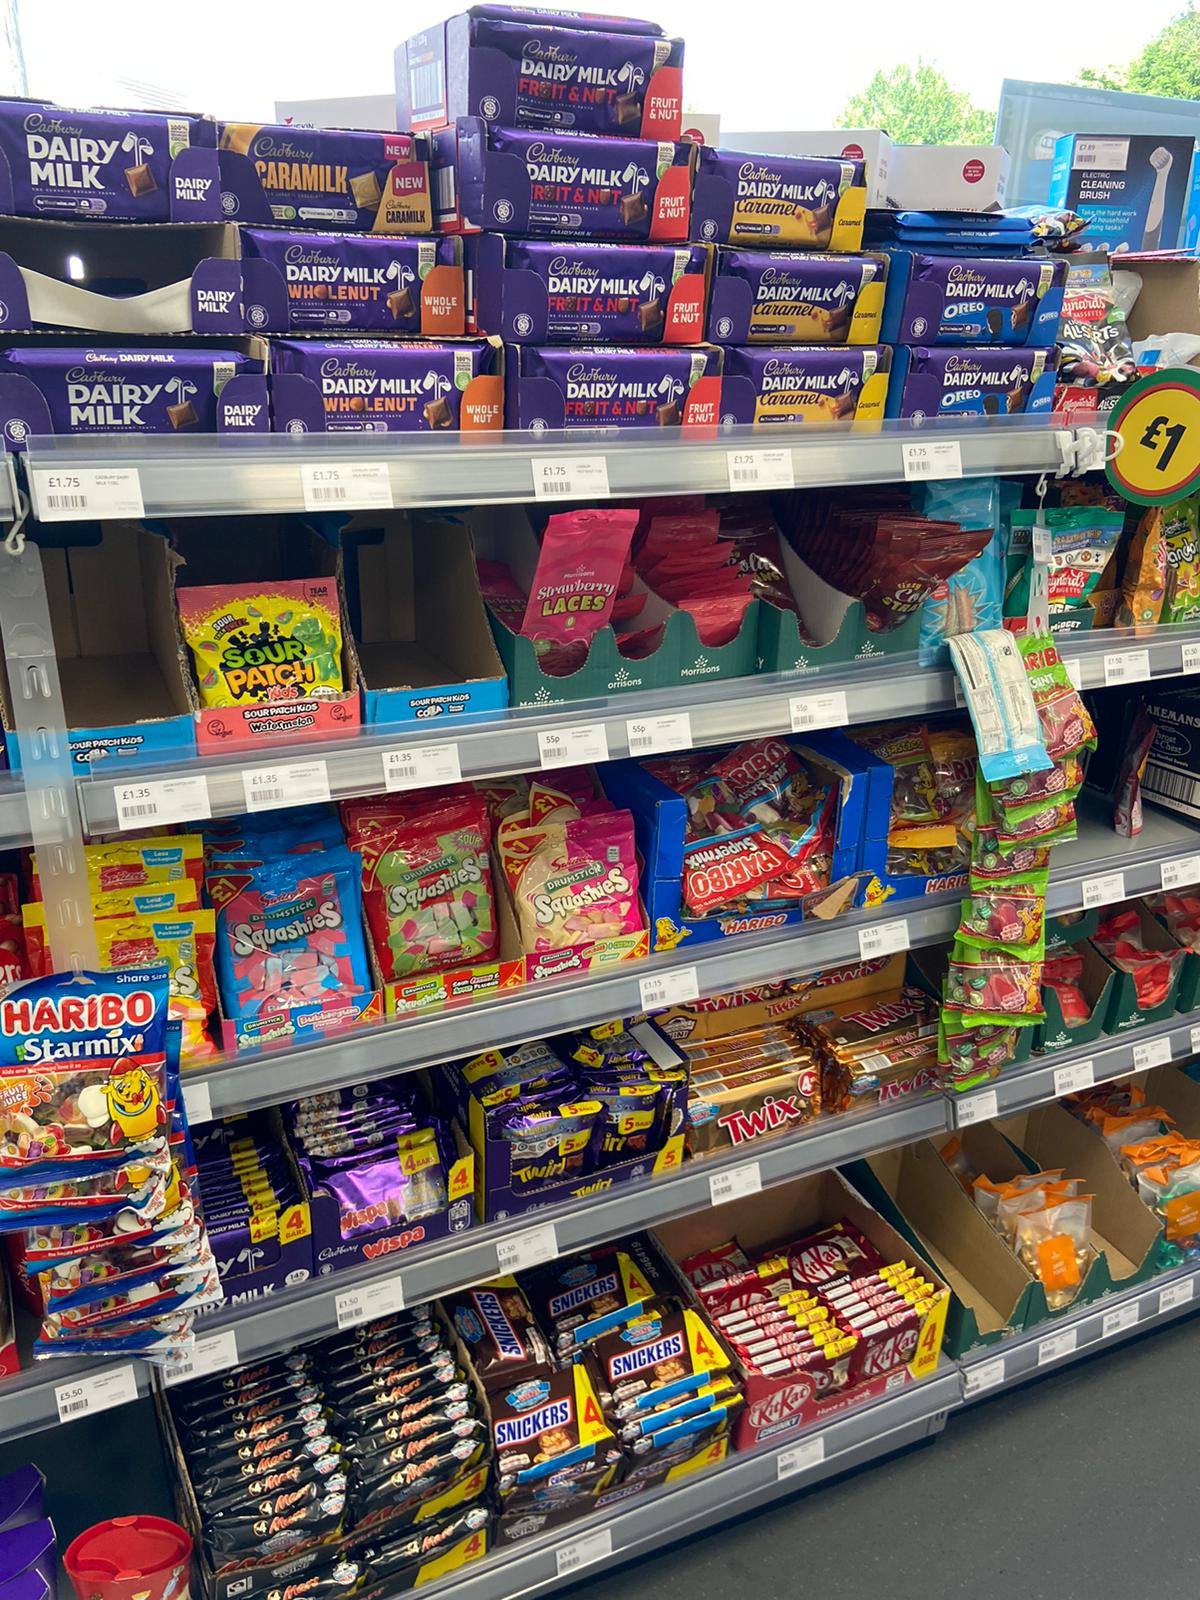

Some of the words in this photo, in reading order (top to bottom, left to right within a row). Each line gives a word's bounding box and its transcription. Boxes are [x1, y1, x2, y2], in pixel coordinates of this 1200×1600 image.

[650, 97, 678, 109] FRUIT
[649, 109, 656, 119] &
[657, 109, 679, 120] NUT
[24, 113, 83, 136] Cadbury
[26, 134, 120, 164] DAIRY
[253, 136, 313, 161] Cadbury
[385, 145, 411, 156] NEW
[30, 161, 105, 189] MILK
[254, 160, 348, 194] CARAMILK
[395, 177, 423, 189] NEW
[1080, 180, 1126, 190] CLEANING
[659, 197, 685, 208] FRUIT
[1079, 191, 1111, 200] BRUSH
[659, 208, 666, 218] &
[666, 208, 686, 218] NUT
[736, 198, 799, 216] Caramel
[386, 210, 425, 224] CARAMILK
[284, 245, 340, 265] Cadbury
[548, 256, 599, 277] Cadbury
[600, 280, 640, 295] MILK
[757, 286, 801, 300] DAIRY
[800, 287, 833, 301] MILK
[946, 282, 985, 298] DAIRY
[198, 301, 229, 313] MILK
[424, 297, 457, 307] WHOLE
[674, 303, 699, 313] FRUIT
[754, 303, 814, 316] Caramel
[432, 305, 452, 316] NUT
[672, 313, 679, 323] &
[680, 313, 700, 323] NUT
[944, 302, 985, 319] OREO
[65, 366, 126, 385] Cadbury
[320, 357, 376, 378] Cadbury
[566, 363, 618, 384] Cadbury
[322, 379, 379, 394] DAIRY
[381, 379, 424, 394] MILK
[762, 376, 806, 390] DAIRY
[805, 376, 837, 389] MILK
[943, 371, 982, 386] DAIRY
[67, 384, 163, 405] DAIRY
[566, 383, 618, 399] DAIRY
[618, 383, 658, 399] MILK
[941, 389, 981, 407] OREO
[760, 393, 820, 406] Caramel
[70, 405, 147, 426] MILK
[224, 405, 262, 417] DAIRY
[466, 405, 499, 415] WHOLE
[689, 403, 714, 414] FRUIT
[224, 415, 256, 426] MILK
[473, 413, 493, 424] NUT
[687, 413, 695, 423] &
[695, 413, 715, 423] NUT
[1140, 416, 1187, 471] £1
[734, 455, 755, 465] £1.75
[909, 448, 927, 457] £1.75
[313, 470, 340, 481] £1.75
[543, 466, 566, 476] £1.75
[48, 477, 80, 488] £1.75
[309, 586, 328, 594] TEAR
[537, 580, 616, 600] Strawberry
[542, 596, 607, 617] LACES
[213, 614, 234, 631] SOUR
[224, 640, 304, 668] SOUR
[681, 665, 720, 676] Morrisons
[224, 661, 315, 698] PATCH
[608, 678, 642, 689] orrisons
[410, 698, 430, 707] SOUR
[430, 696, 452, 704] PATCH
[795, 704, 808, 712] 55p
[244, 707, 269, 719] SOUR
[270, 705, 297, 716] PATCH
[1147, 705, 1200, 728] AKEMANS
[250, 717, 314, 733] Watermelon
[632, 725, 646, 734] 55p
[93, 737, 121, 747] PATCH
[546, 735, 560, 744] 55p
[390, 753, 412, 762] £1.35
[252, 775, 278, 785] £1.35
[122, 788, 151, 799] £1.35
[458, 835, 481, 846] SOUR
[685, 837, 759, 869] Supermix
[403, 856, 455, 881] DRUMSTICK
[690, 850, 781, 899] HARIBO
[547, 863, 603, 891] DRUMSTICK
[252, 901, 314, 921] DRUMSTICK
[725, 914, 787, 935] HARIBO
[117, 974, 149, 983] Share
[151, 973, 167, 981] size
[686, 986, 765, 1013] Twix
[767, 993, 812, 1017] Twix
[2, 991, 155, 1036] HARIBO
[841, 997, 926, 1033] Twix
[24, 1030, 138, 1061] Starmix
[569, 1105, 578, 1114] 5
[624, 1118, 634, 1130] 5
[718, 1096, 800, 1146] Twix
[565, 1139, 575, 1150] 5
[664, 1151, 675, 1163] 5
[453, 1168, 467, 1185] 4
[513, 1157, 567, 1183] Twirl
[452, 1183, 470, 1193] BARS
[571, 1178, 613, 1198] Twirl
[286, 1211, 304, 1231] 4
[340, 1200, 389, 1231] Wispa
[286, 1228, 306, 1239] BARS
[362, 1226, 425, 1259] Wispa
[793, 1246, 844, 1283] KitKat
[551, 1275, 616, 1315] SNICKERS
[339, 1298, 359, 1309] £1.50
[475, 1292, 522, 1357] SNICKERS
[695, 1332, 715, 1358] 4
[922, 1323, 936, 1351] 4
[612, 1335, 682, 1376] SNICKERS
[865, 1330, 918, 1376] KitKat
[917, 1352, 936, 1367] BARS
[60, 1388, 83, 1401] £5.50
[584, 1396, 603, 1424] 4
[752, 1385, 811, 1427] KitKat
[496, 1402, 569, 1444] SNICKERS
[760, 1416, 799, 1438] CHUNKY
[254, 1432, 289, 1456] Mars
[257, 1449, 292, 1474] Mars
[275, 1484, 312, 1512] Mars
[269, 1509, 306, 1534] Mars
